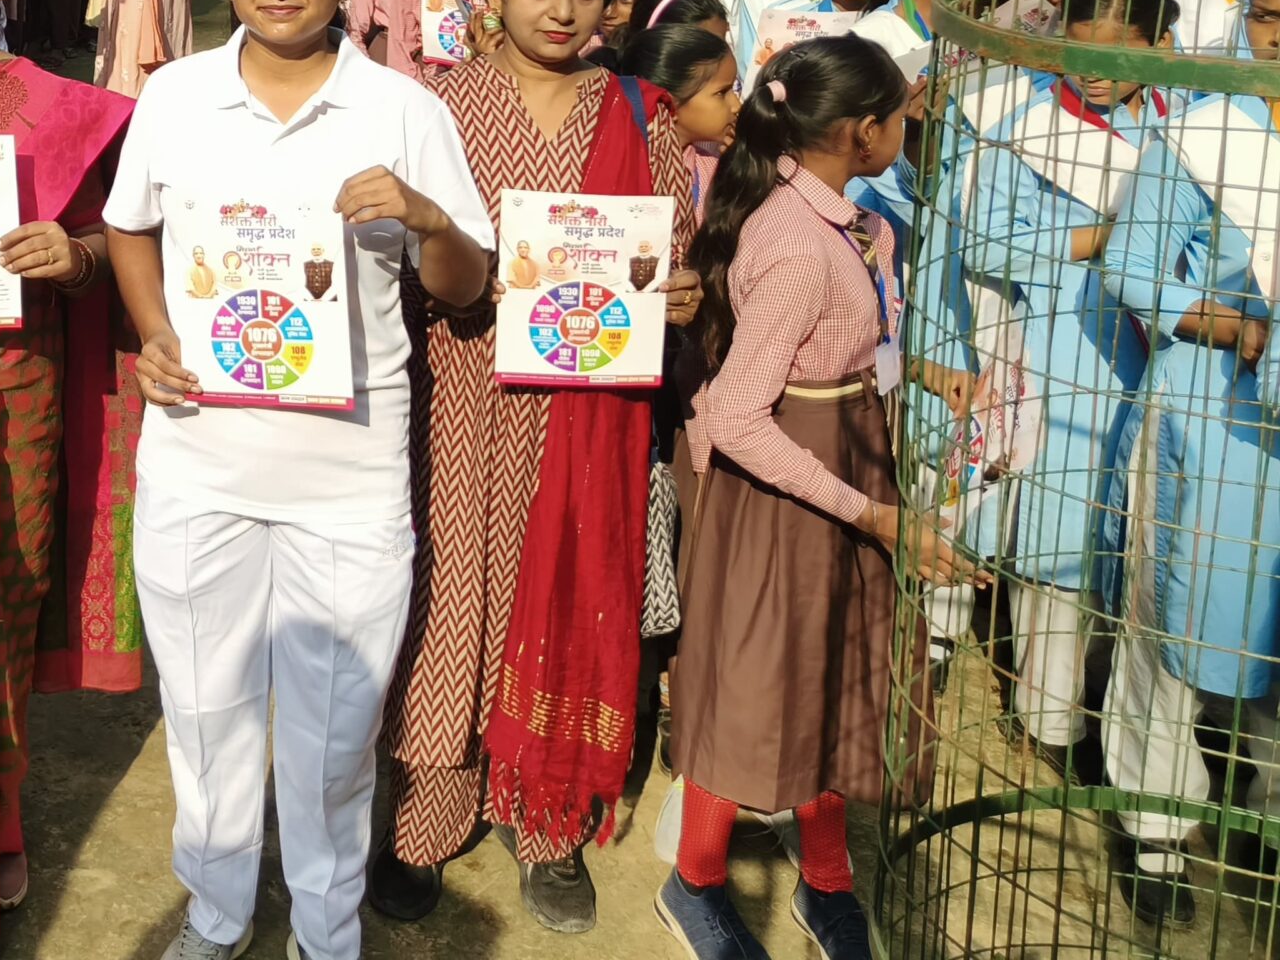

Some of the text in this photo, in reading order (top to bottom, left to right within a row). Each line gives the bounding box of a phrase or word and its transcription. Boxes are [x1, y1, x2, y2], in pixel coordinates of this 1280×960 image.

[269, 226, 295, 239] प्रदेश
[598, 225, 625, 237] प्रदेश
[565, 315, 595, 330] 1076
[246, 327, 277, 343] 1076
[291, 346, 305, 354] 108
